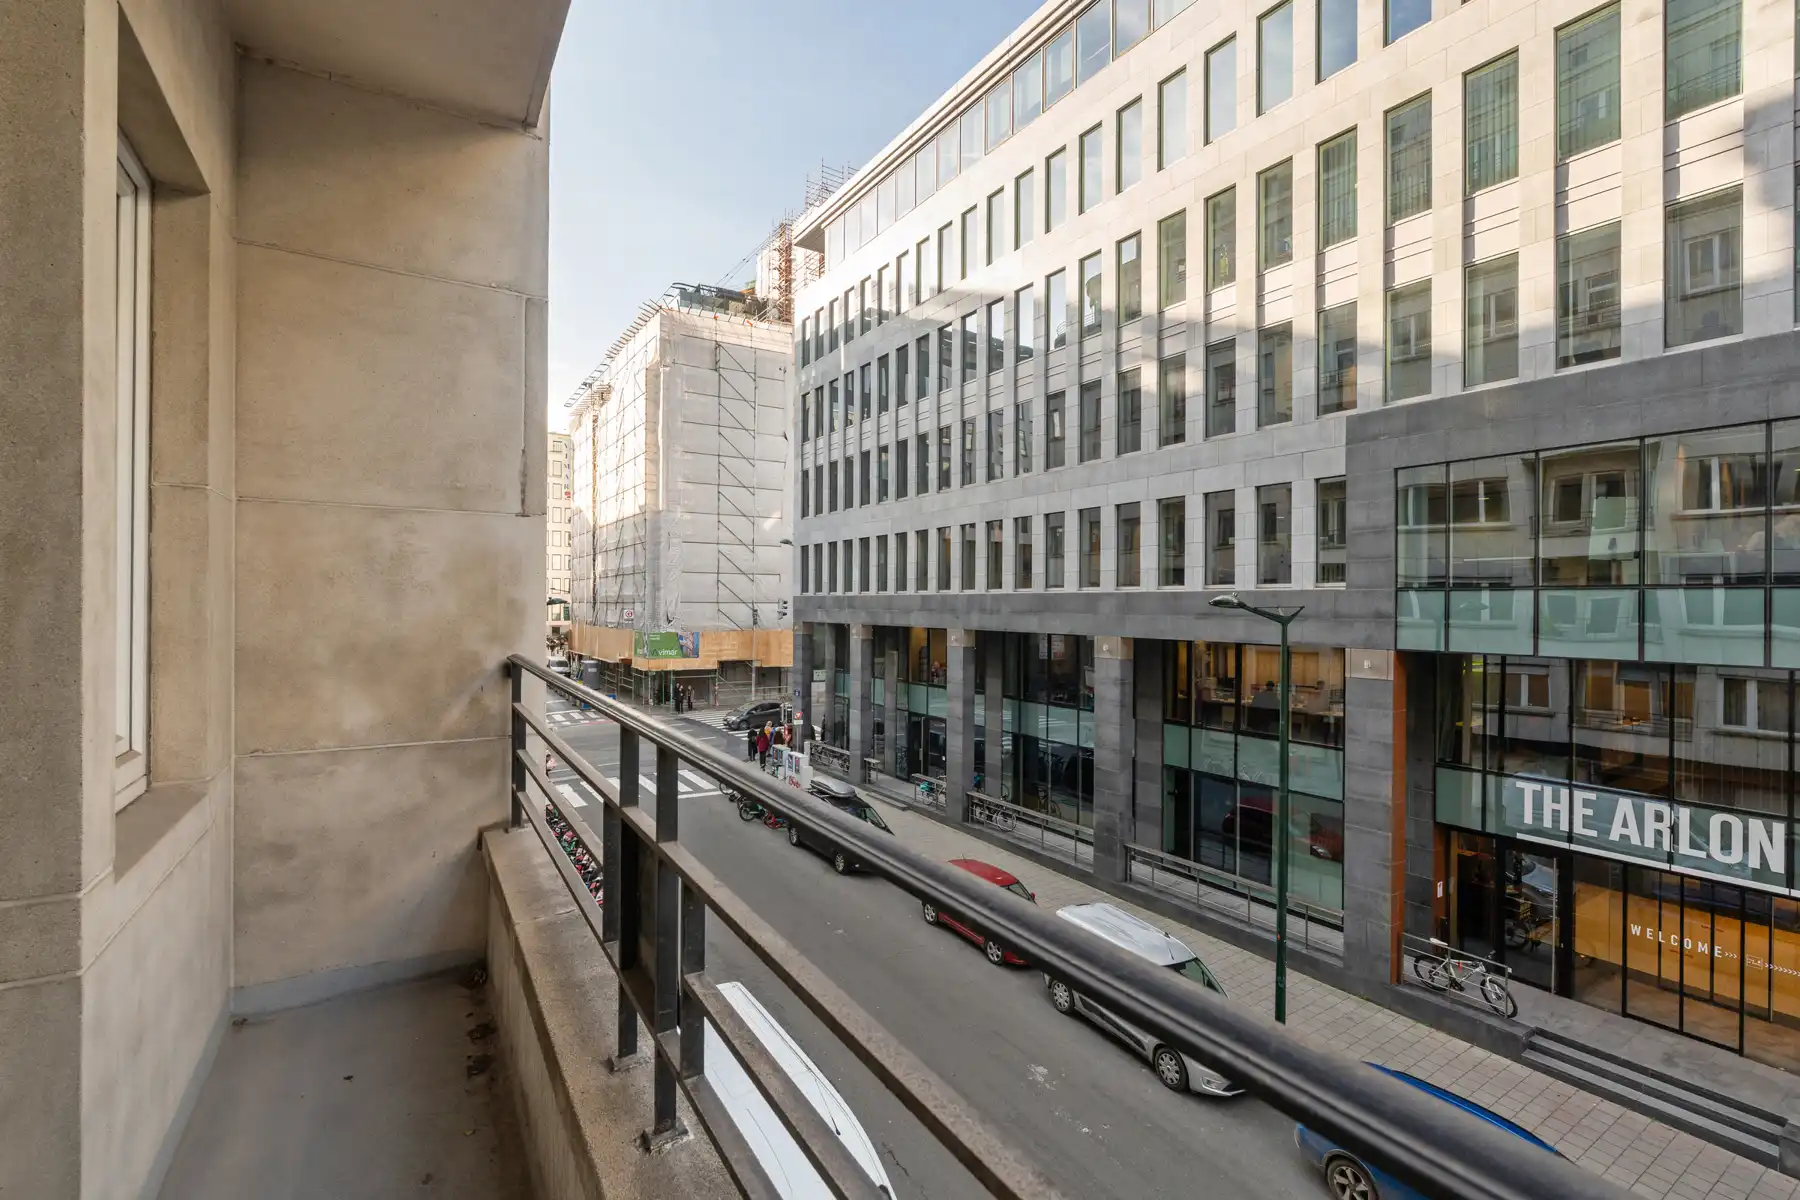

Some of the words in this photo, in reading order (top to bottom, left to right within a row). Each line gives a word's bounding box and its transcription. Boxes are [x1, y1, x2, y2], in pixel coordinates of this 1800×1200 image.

[658, 648, 678, 656] vimar
[1515, 781, 1598, 837] THE
[1608, 798, 1786, 874] ARLON
[1630, 923, 1723, 959] WELCOME
